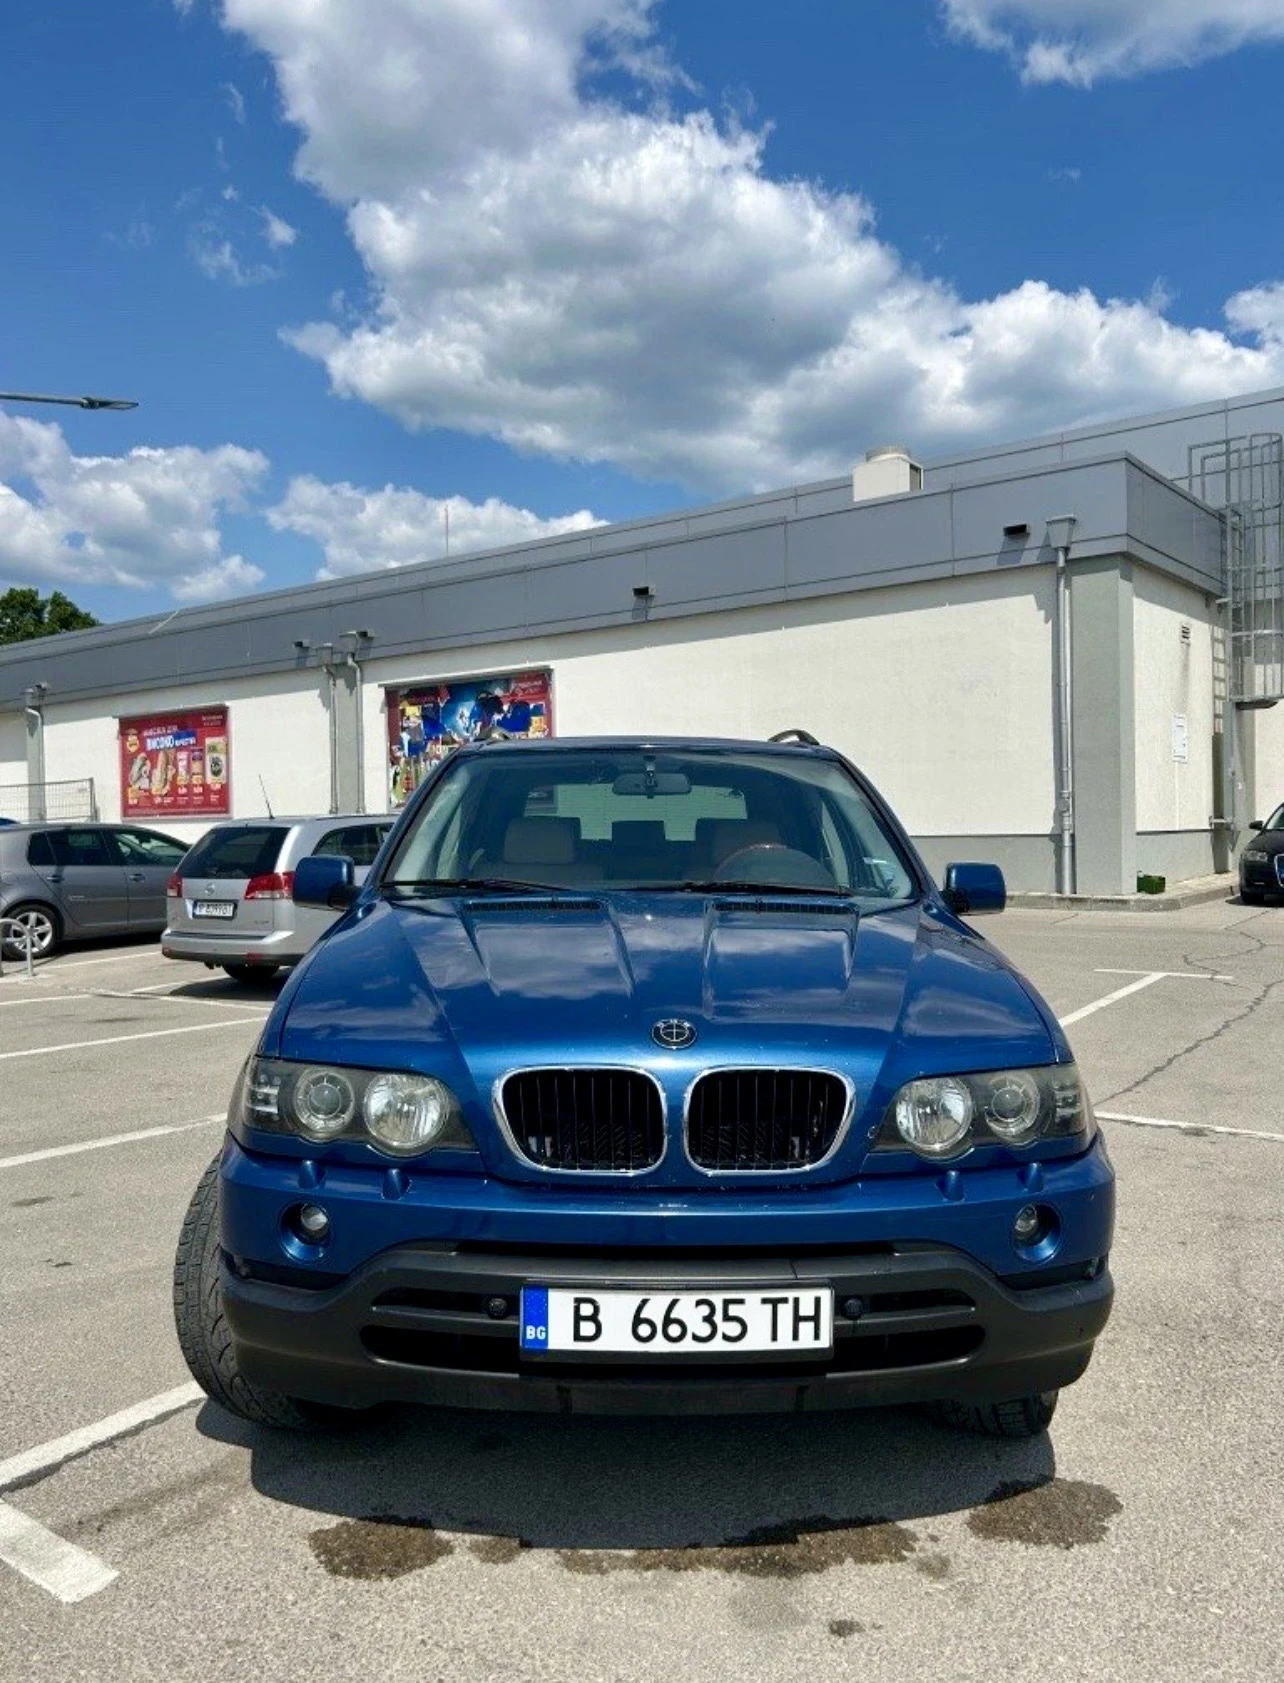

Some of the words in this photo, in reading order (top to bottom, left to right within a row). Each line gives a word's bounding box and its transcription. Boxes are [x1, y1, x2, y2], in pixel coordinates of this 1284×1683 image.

[526, 1325, 546, 1340] BG
[572, 1297, 603, 1342] B
[631, 1298, 748, 1343] 6635
[760, 1296, 822, 1342] TH
